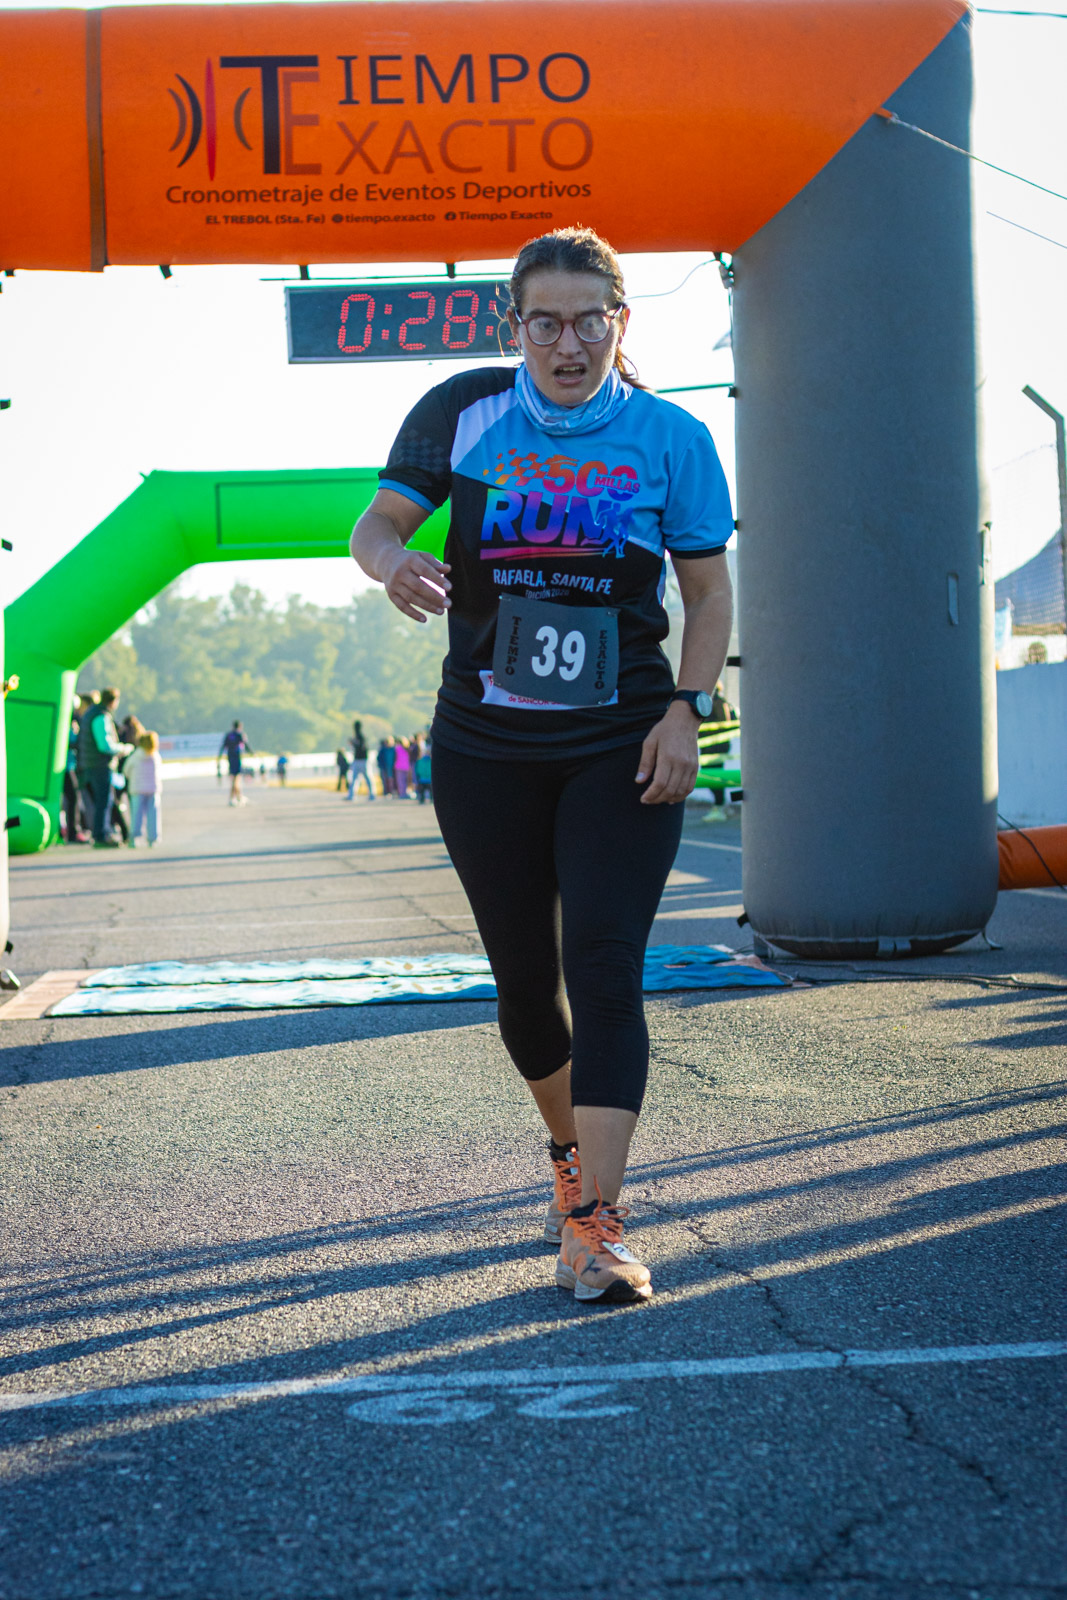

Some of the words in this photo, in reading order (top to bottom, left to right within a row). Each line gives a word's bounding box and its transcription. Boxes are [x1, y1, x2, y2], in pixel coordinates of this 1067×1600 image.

[166, 184, 323, 205] Cronometraje
[329, 184, 358, 202] de
[365, 182, 456, 201] Eventos
[463, 180, 591, 202] Deportivos
[205, 215, 220, 225] EL
[222, 215, 272, 225] TREBOL
[274, 214, 304, 225] (Sta.
[306, 213, 326, 225] Fe)
[459, 211, 507, 223] Tiempo
[510, 210, 553, 221] Exacto
[337, 289, 516, 353] 0:28:
[542, 455, 638, 501] 500
[594, 474, 640, 494] MILLAS
[480, 488, 612, 546] RUN
[493, 568, 546, 587] RAFAELA,
[550, 572, 595, 592] SANTA
[596, 578, 613, 595] FE
[505, 615, 522, 676] TIEMPO
[531, 625, 586, 681] 39
[594, 630, 608, 690] EXACTO
